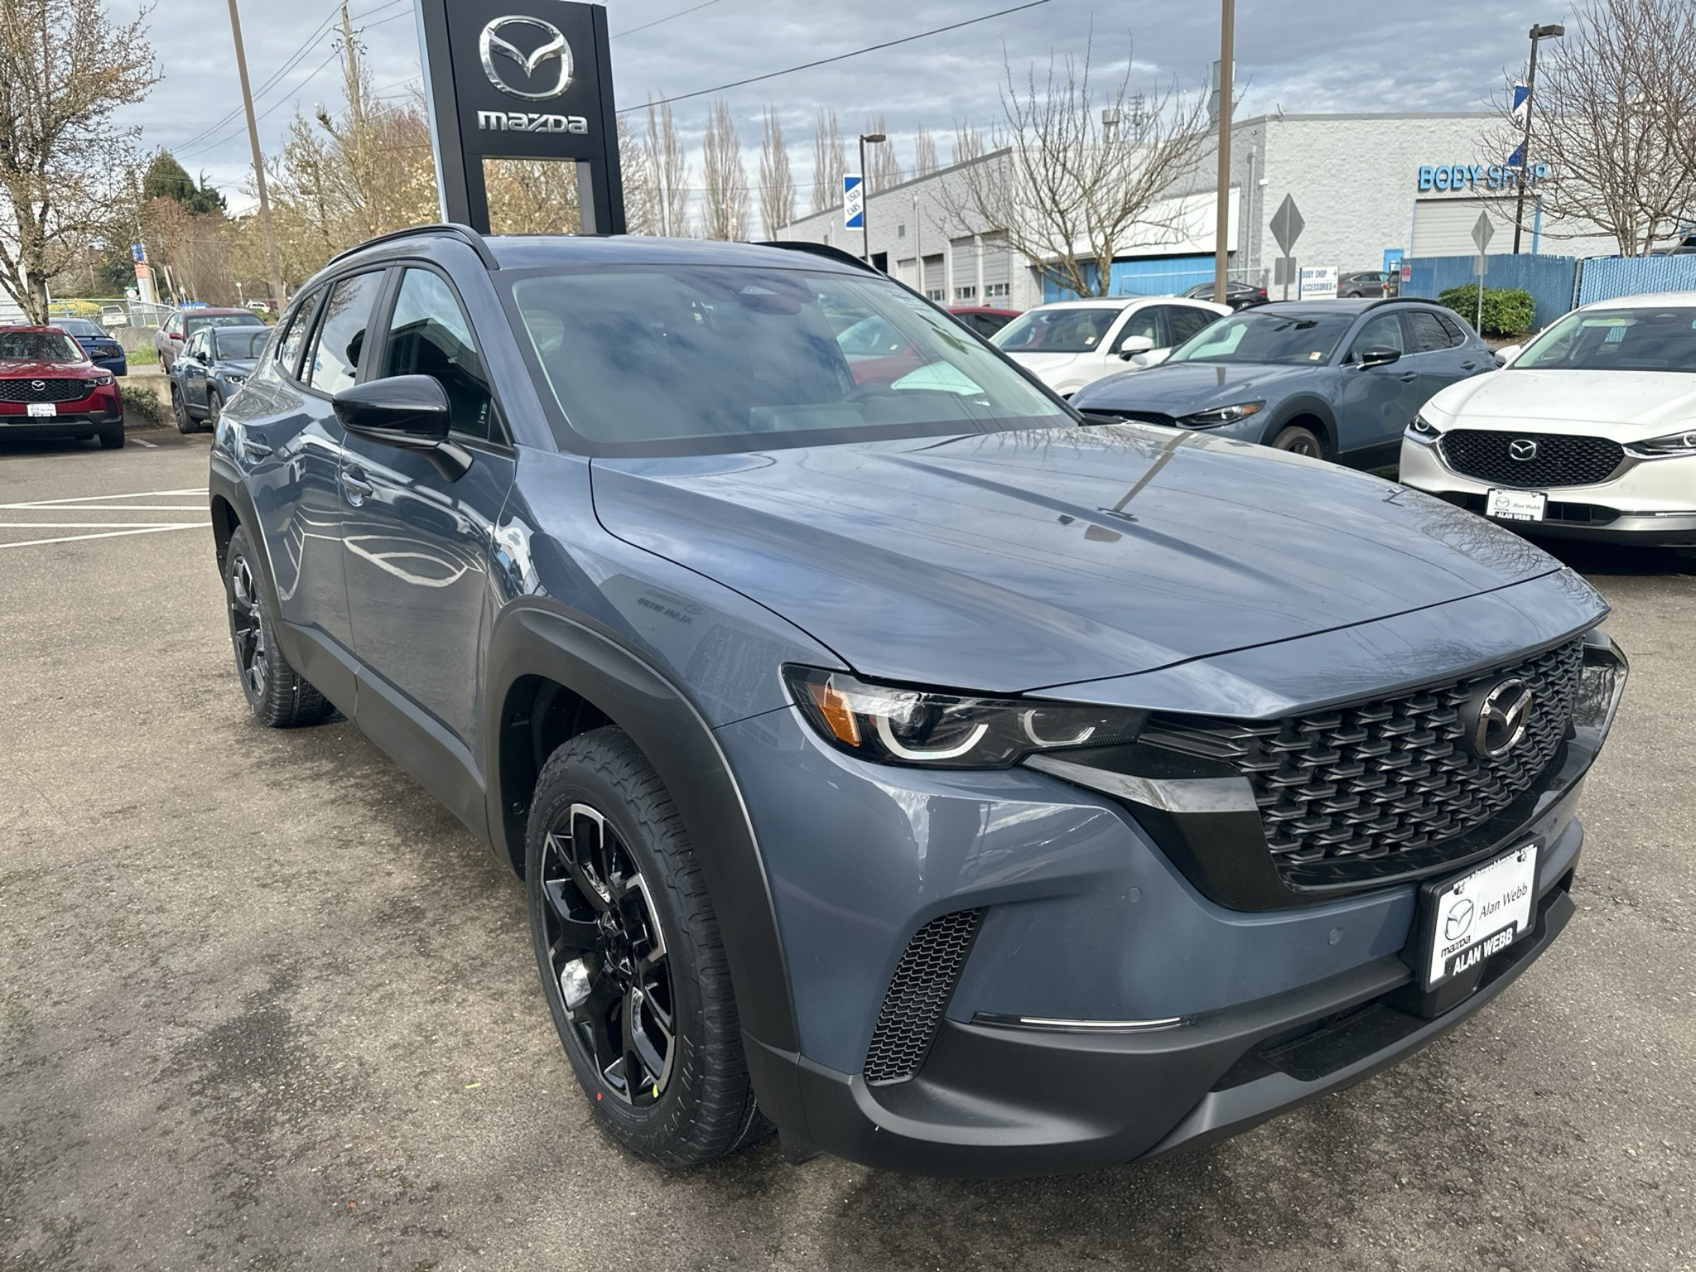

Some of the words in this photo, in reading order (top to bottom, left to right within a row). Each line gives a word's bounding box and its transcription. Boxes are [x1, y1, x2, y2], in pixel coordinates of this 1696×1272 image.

[1418, 164, 1481, 190] BODY
[846, 189, 861, 202] USED
[846, 203, 861, 216] CARS
[1315, 270, 1327, 278] SHOP
[1302, 283, 1333, 292] ACCESSORIES
[1497, 511, 1513, 519] ALAN
[1513, 513, 1532, 521] WEBB
[1479, 900, 1501, 920] Alan
[1503, 882, 1528, 906] Webb
[1453, 944, 1482, 976] ALAN
[1483, 928, 1513, 957] WEBB
